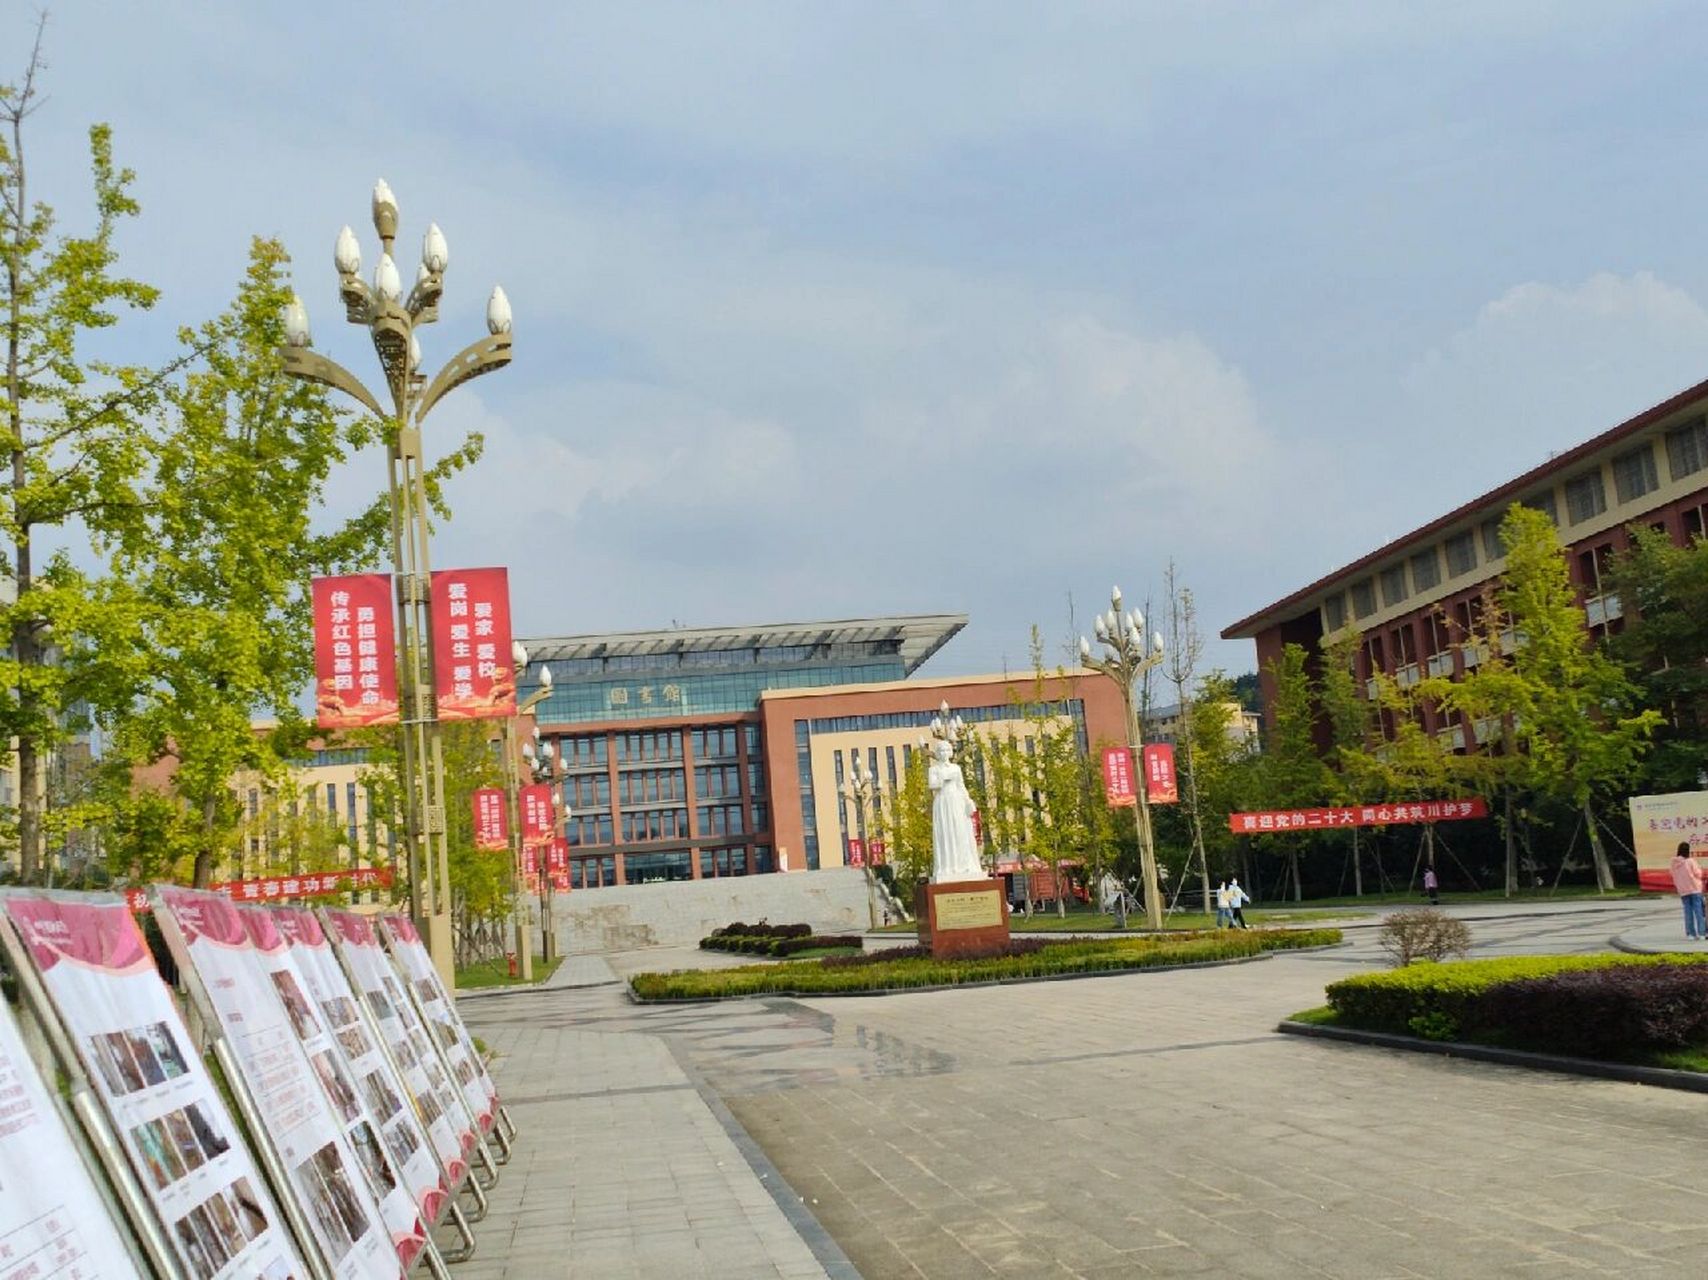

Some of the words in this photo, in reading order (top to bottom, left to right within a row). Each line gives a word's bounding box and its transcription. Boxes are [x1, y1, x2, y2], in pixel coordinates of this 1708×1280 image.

[448, 583, 468, 617] 爱岗
[330, 590, 353, 690] 传承红色基因
[450, 624, 470, 658] 爱生
[1242, 810, 1354, 829] 喜迎党的二十大
